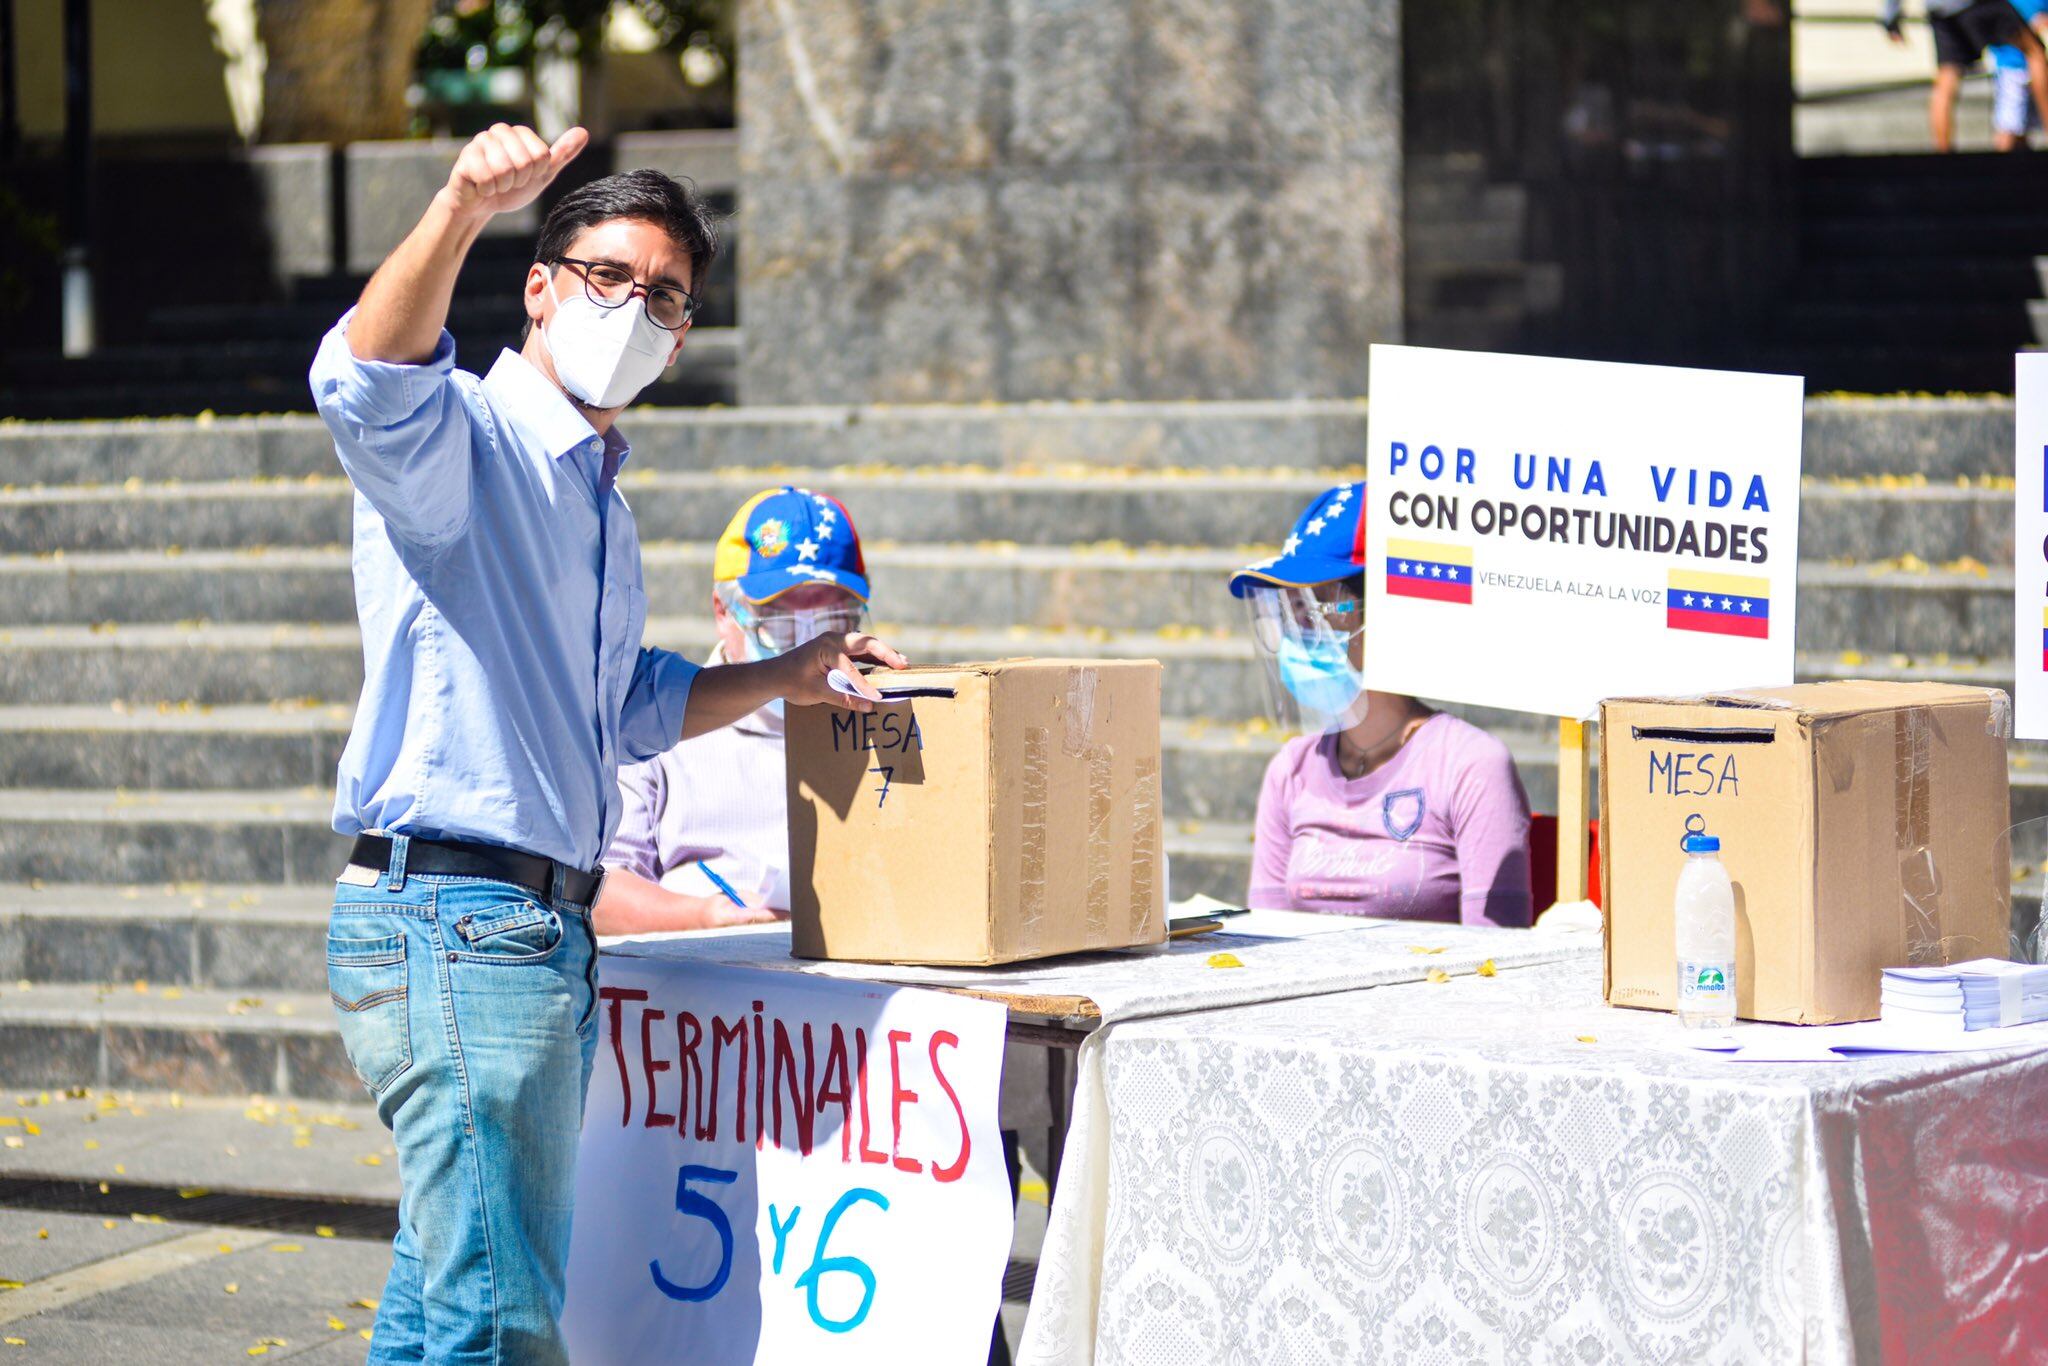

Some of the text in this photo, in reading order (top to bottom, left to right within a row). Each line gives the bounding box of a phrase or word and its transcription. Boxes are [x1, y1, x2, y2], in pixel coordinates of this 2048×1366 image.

[1390, 441, 1770, 513] POR UNA VIDA
[1389, 490, 1769, 564] CON OPORTUNIDADES
[1479, 570, 1662, 605] VENEZUELA ALZA LA VOZ
[830, 710, 923, 752] MESA
[868, 766, 894, 809] 7
[1648, 750, 1739, 797] MESA
[649, 1164, 738, 1302] 5
[794, 1187, 890, 1334] 6
